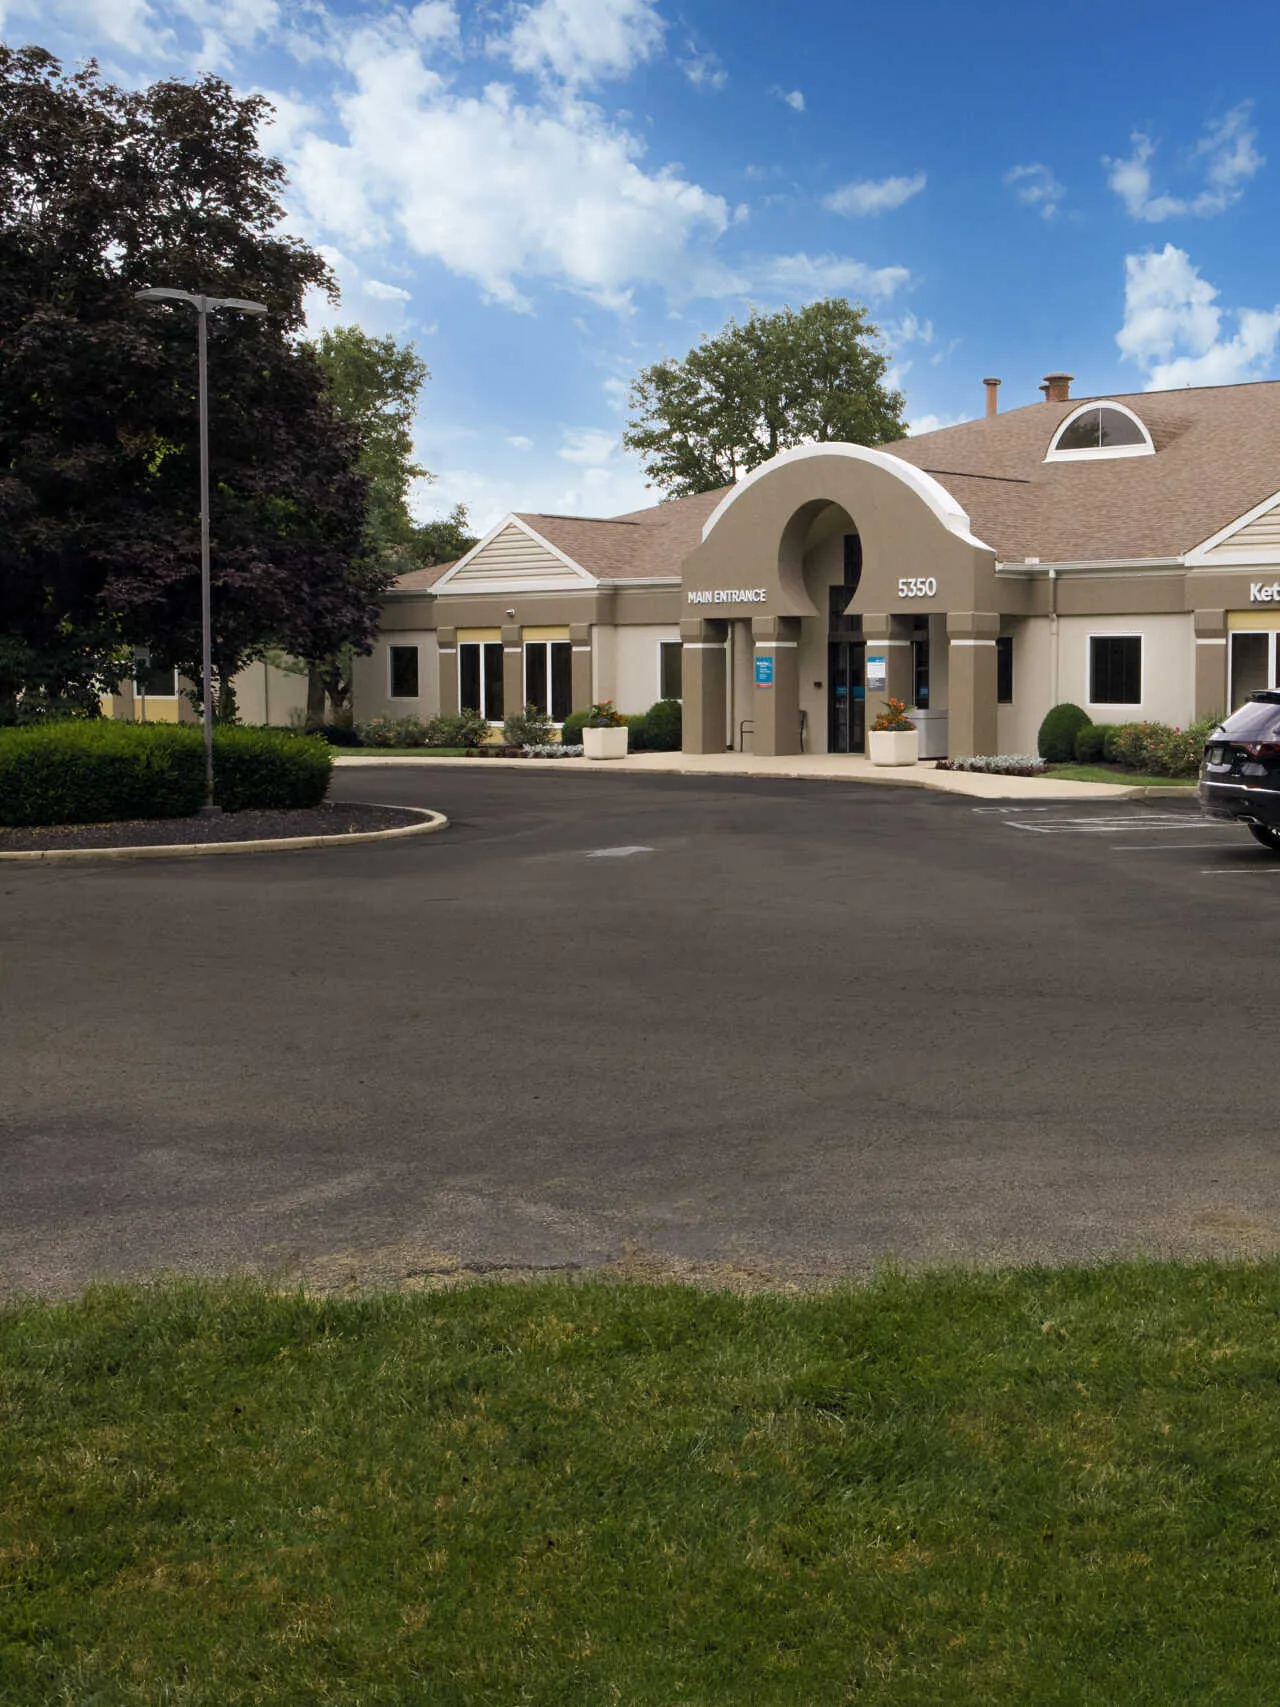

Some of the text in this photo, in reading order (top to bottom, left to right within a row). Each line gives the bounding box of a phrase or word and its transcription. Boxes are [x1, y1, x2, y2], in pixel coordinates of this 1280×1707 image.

[687, 588, 767, 604] MAIN ENTRANCE
[898, 577, 937, 598] 5350
